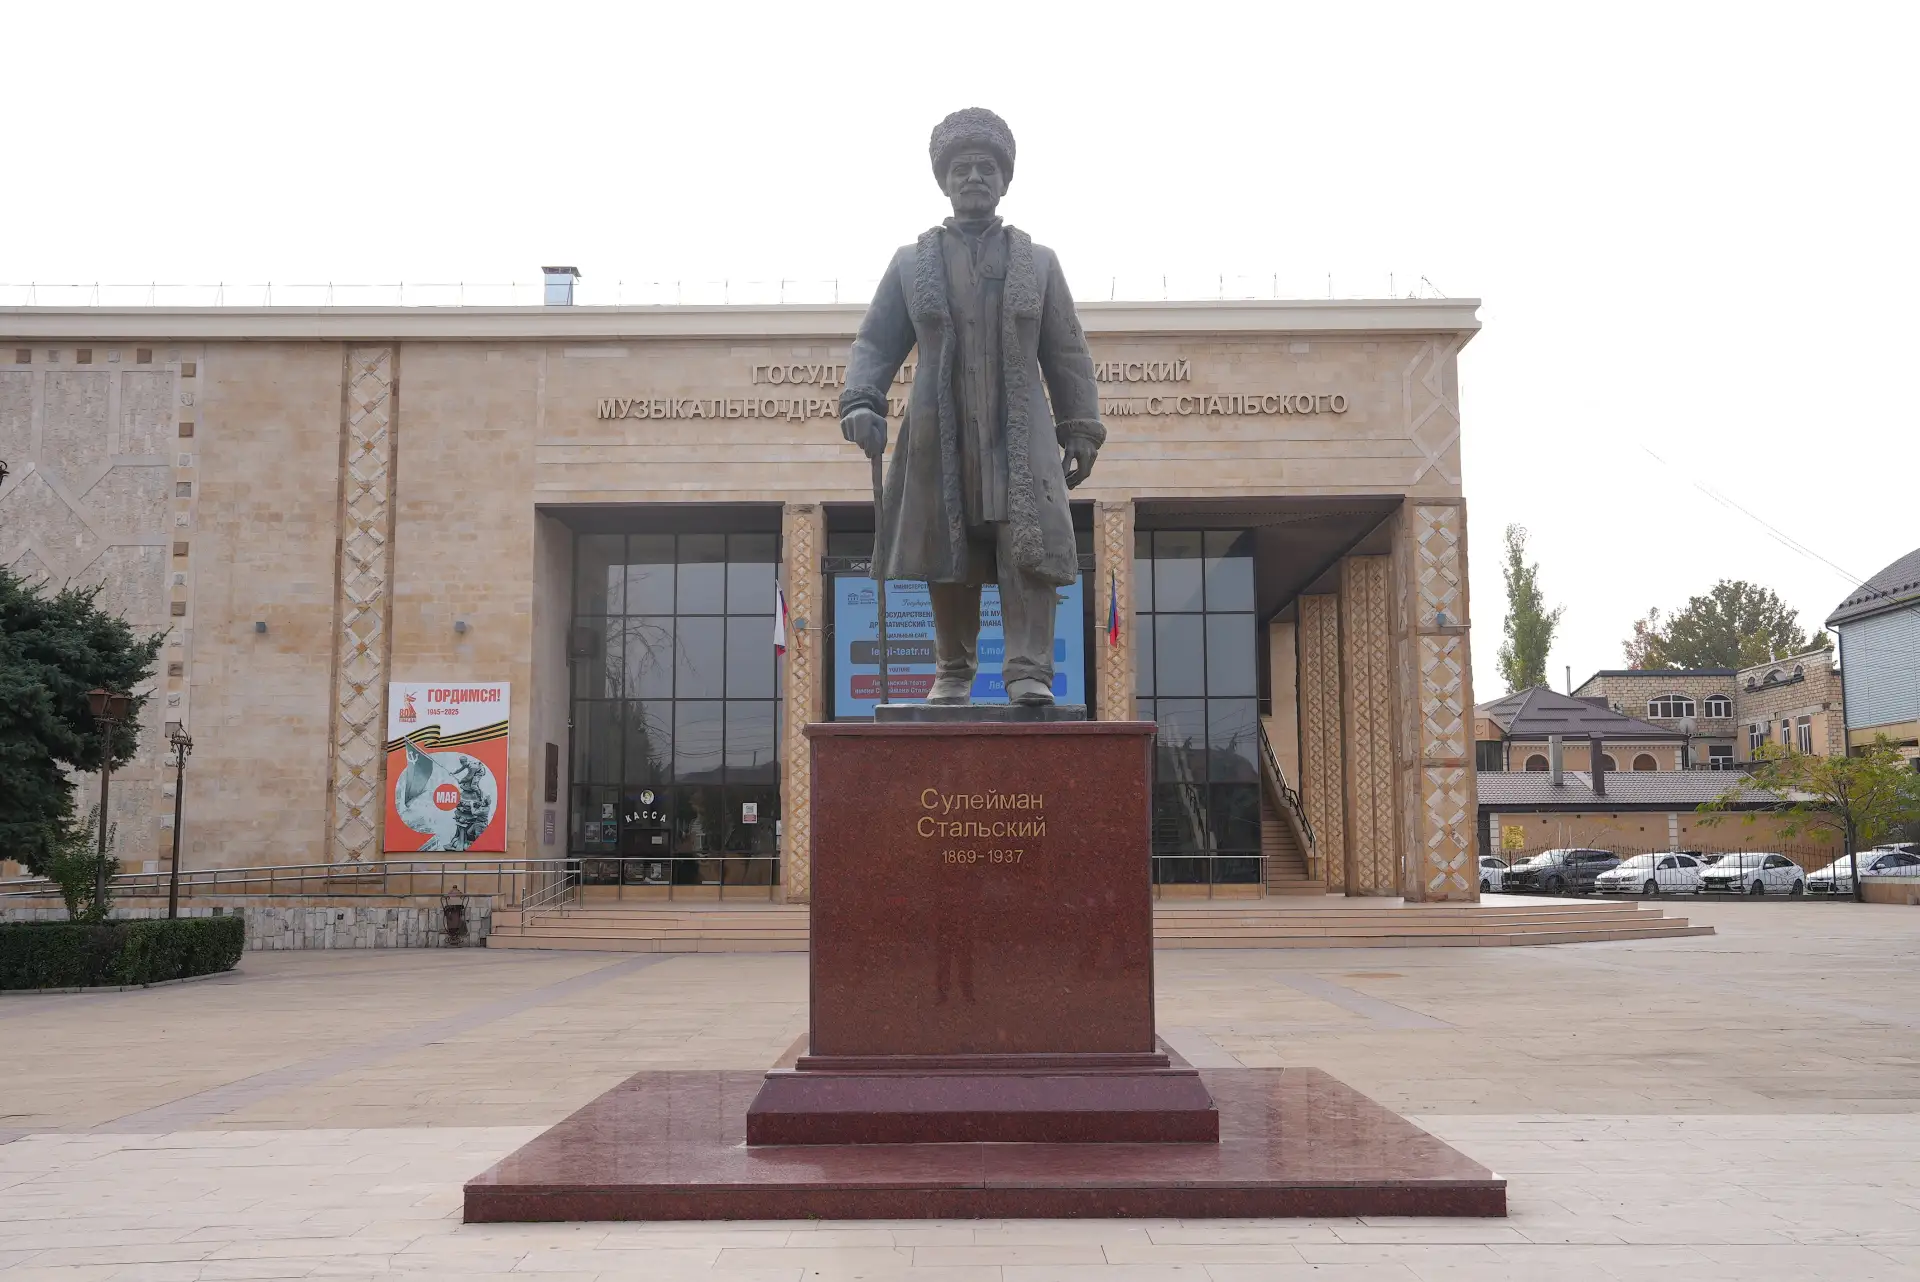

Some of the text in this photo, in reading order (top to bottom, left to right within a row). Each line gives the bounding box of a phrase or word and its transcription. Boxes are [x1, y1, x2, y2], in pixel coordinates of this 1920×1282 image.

[1104, 401, 1140, 416] им.
[1146, 396, 1171, 416] С.
[1176, 392, 1349, 416] СТАЛЬСКОГО
[427, 688, 500, 704] ГОРДИМСЯ!
[436, 791, 457, 803] МАЯ
[920, 788, 1043, 815] Сулейман
[625, 810, 667, 824] КАССА
[917, 815, 1047, 838] Стальский
[941, 849, 1024, 864] 1869-1937
